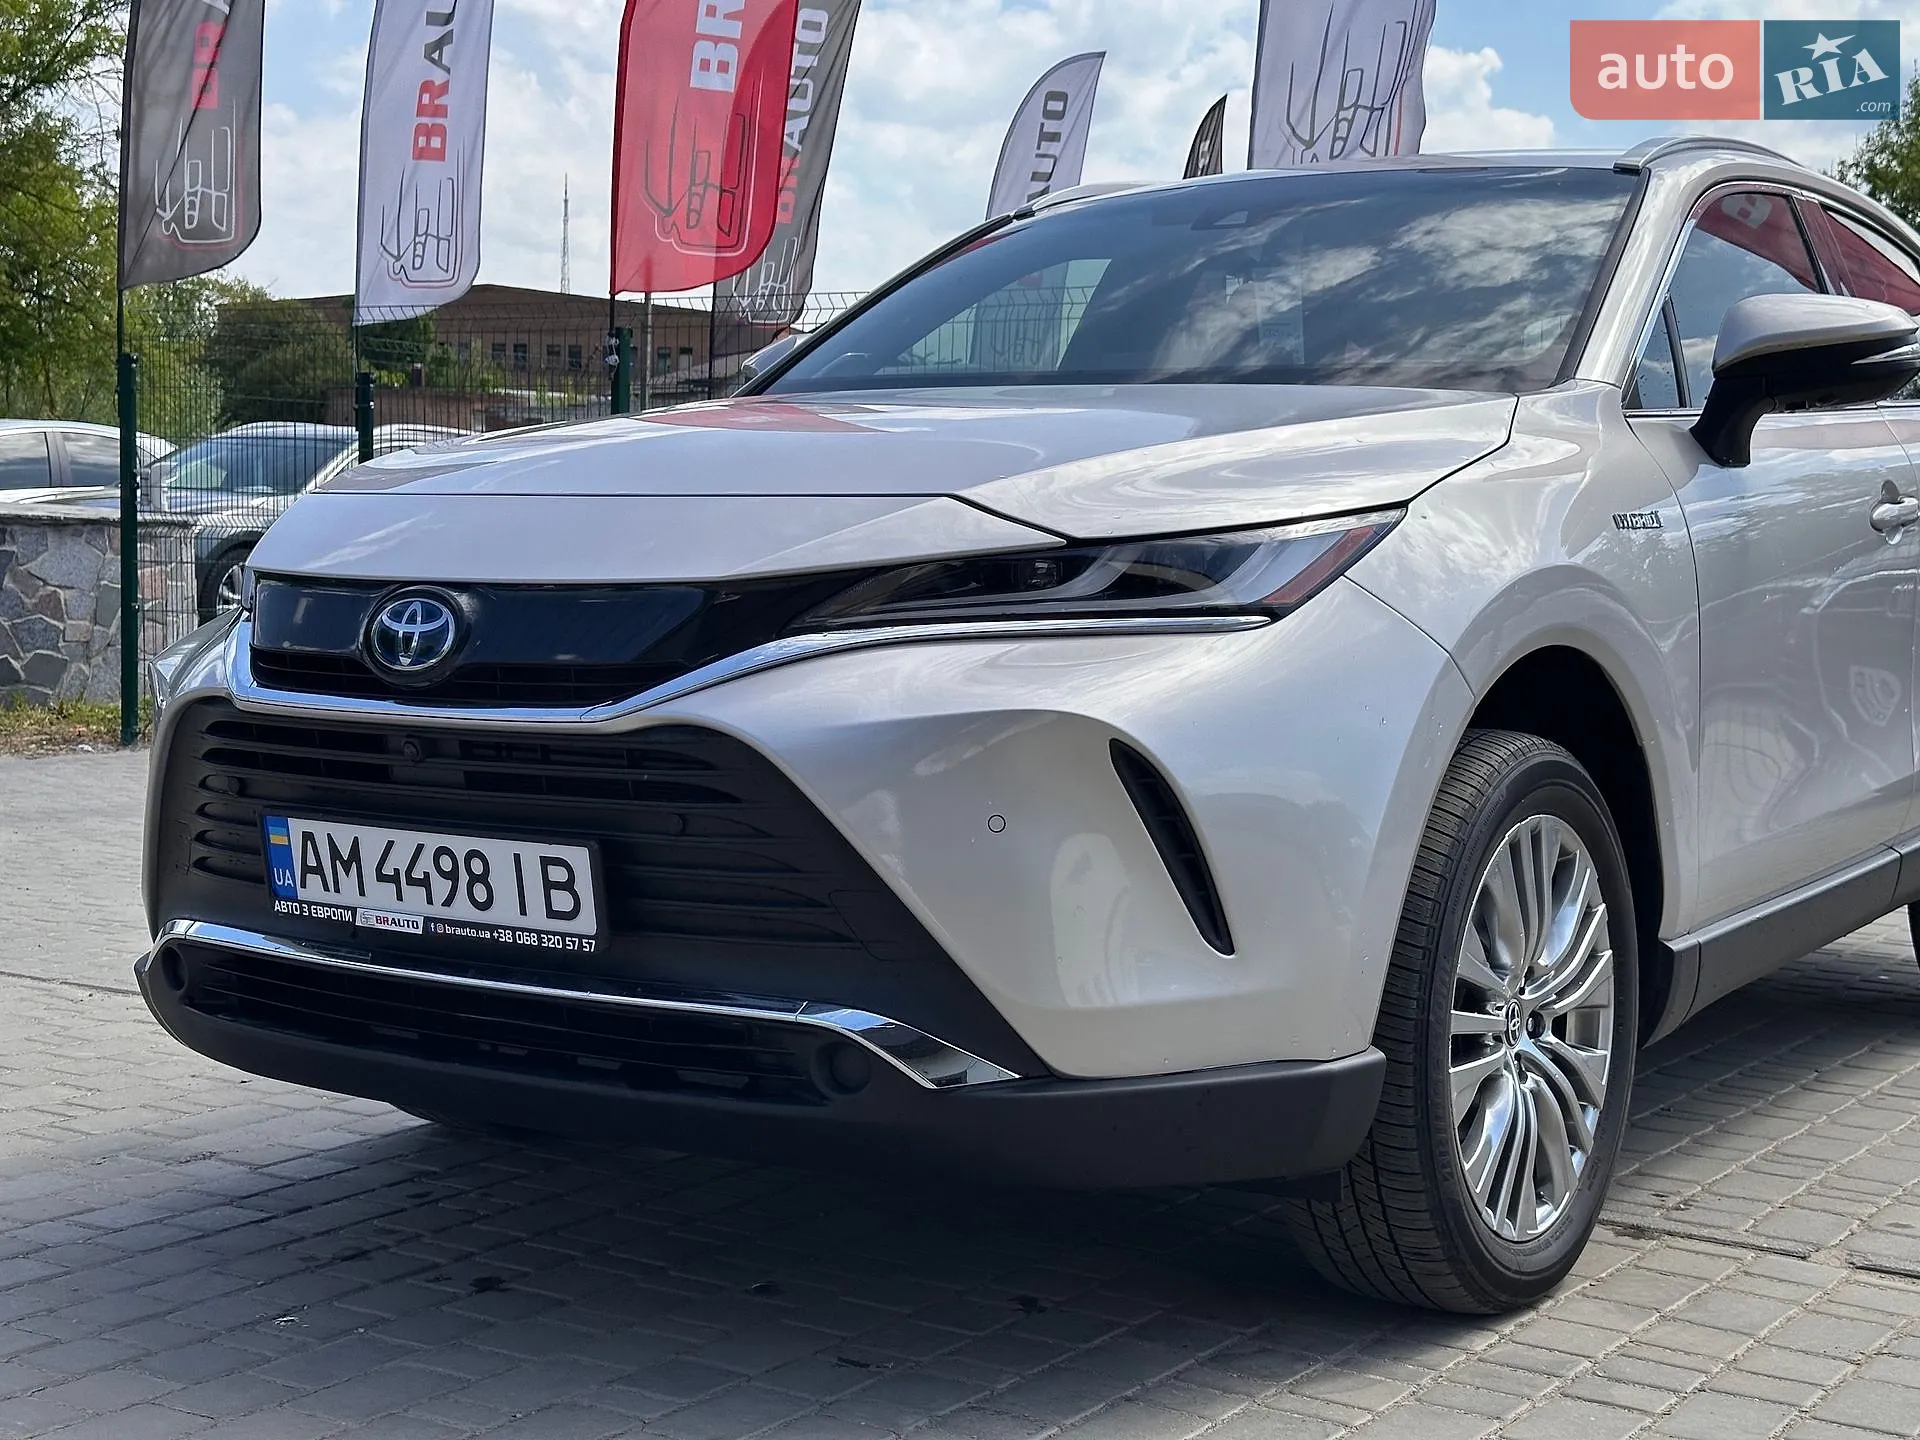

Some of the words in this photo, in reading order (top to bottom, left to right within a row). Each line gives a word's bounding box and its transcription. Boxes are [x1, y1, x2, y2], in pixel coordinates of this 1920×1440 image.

[690, 0, 745, 93] BR
[273, 867, 294, 888] UA
[300, 830, 367, 897] AM
[375, 839, 495, 912] 4498
[274, 900, 300, 916] АВТО
[375, 915, 420, 930] BRAUTO
[445, 924, 491, 939] brauto.ua
[492, 929, 513, 943] +38
[515, 931, 539, 946] 068
[540, 934, 563, 949] 320
[565, 937, 579, 950] 57
[582, 938, 596, 953] 57
